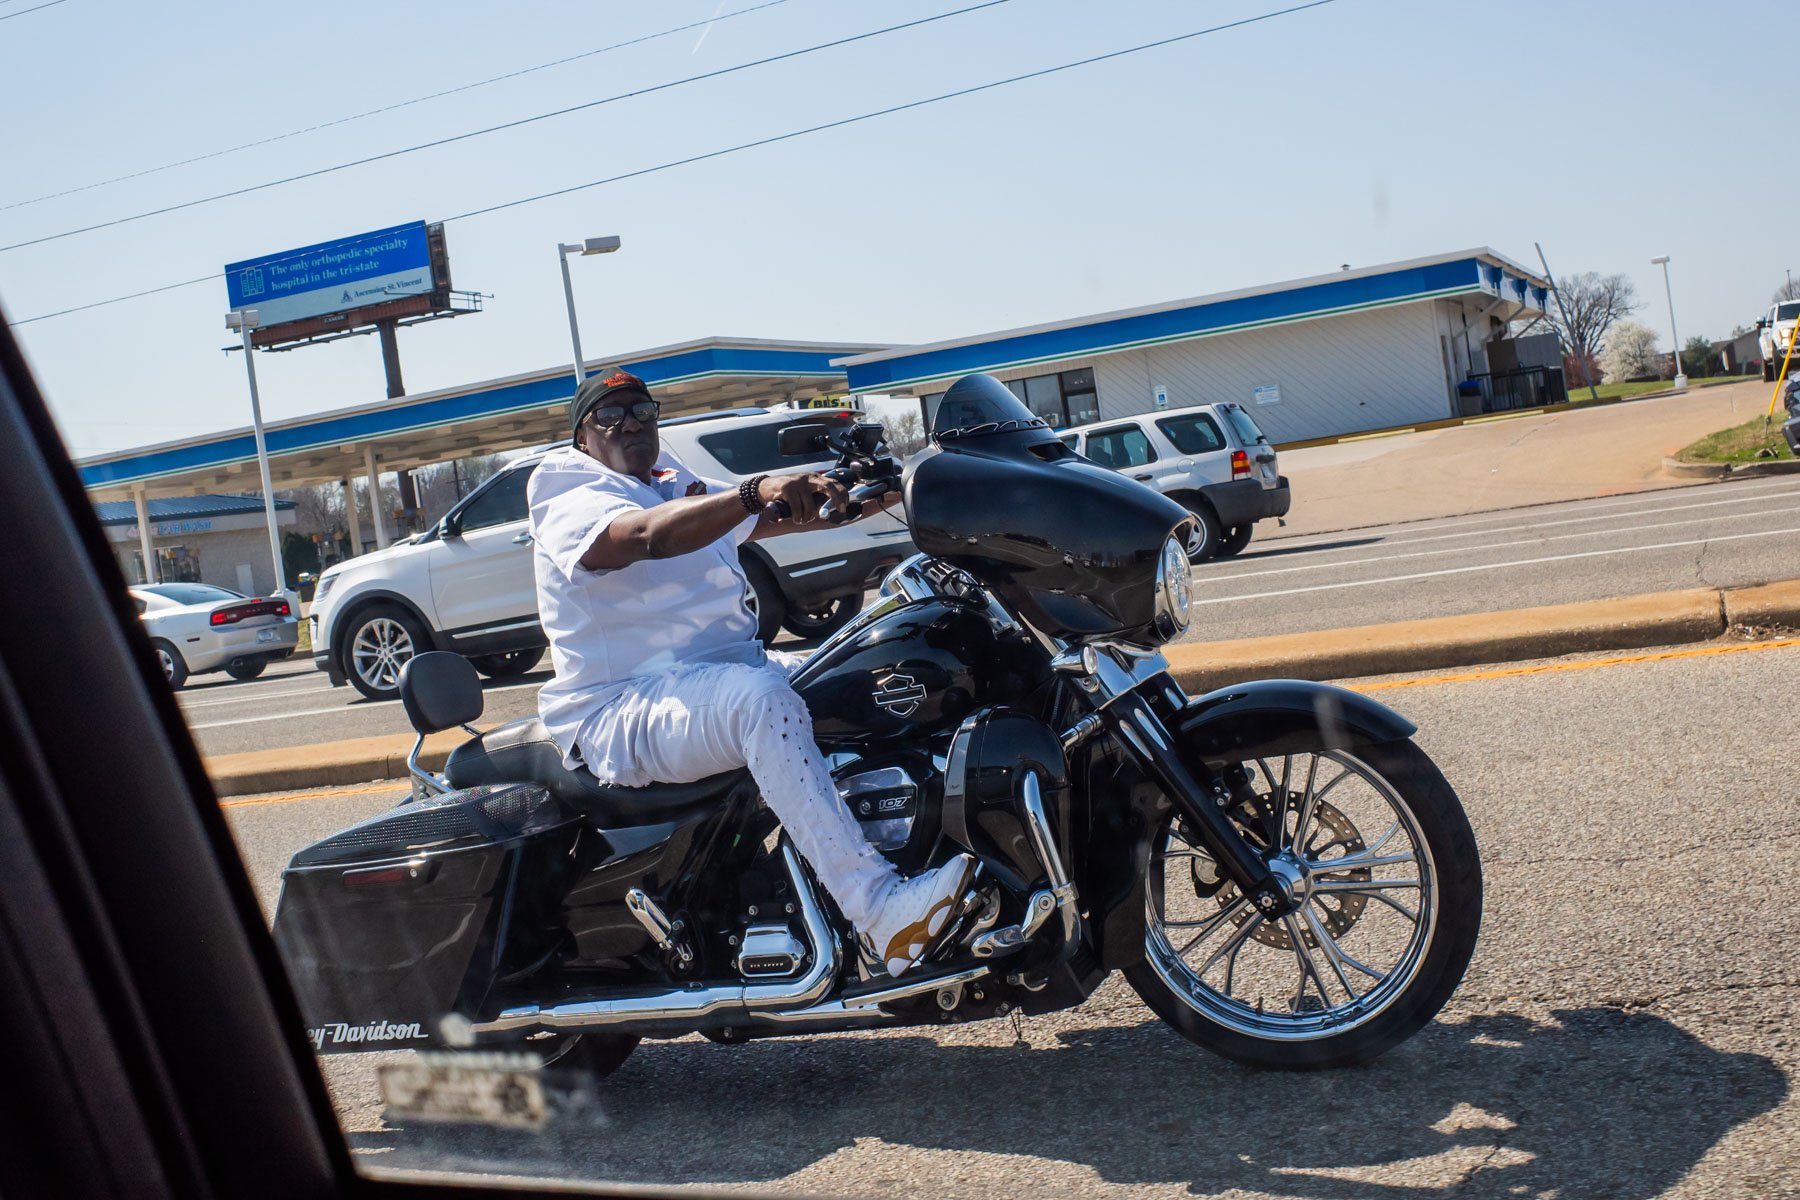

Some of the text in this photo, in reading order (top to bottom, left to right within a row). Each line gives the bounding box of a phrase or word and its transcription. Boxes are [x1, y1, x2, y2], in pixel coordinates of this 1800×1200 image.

[269, 238, 408, 277] The only orthopedic specialty
[271, 260, 380, 291] hospital in the tri-state
[396, 278, 422, 289] Vincent
[878, 796, 908, 810] 107
